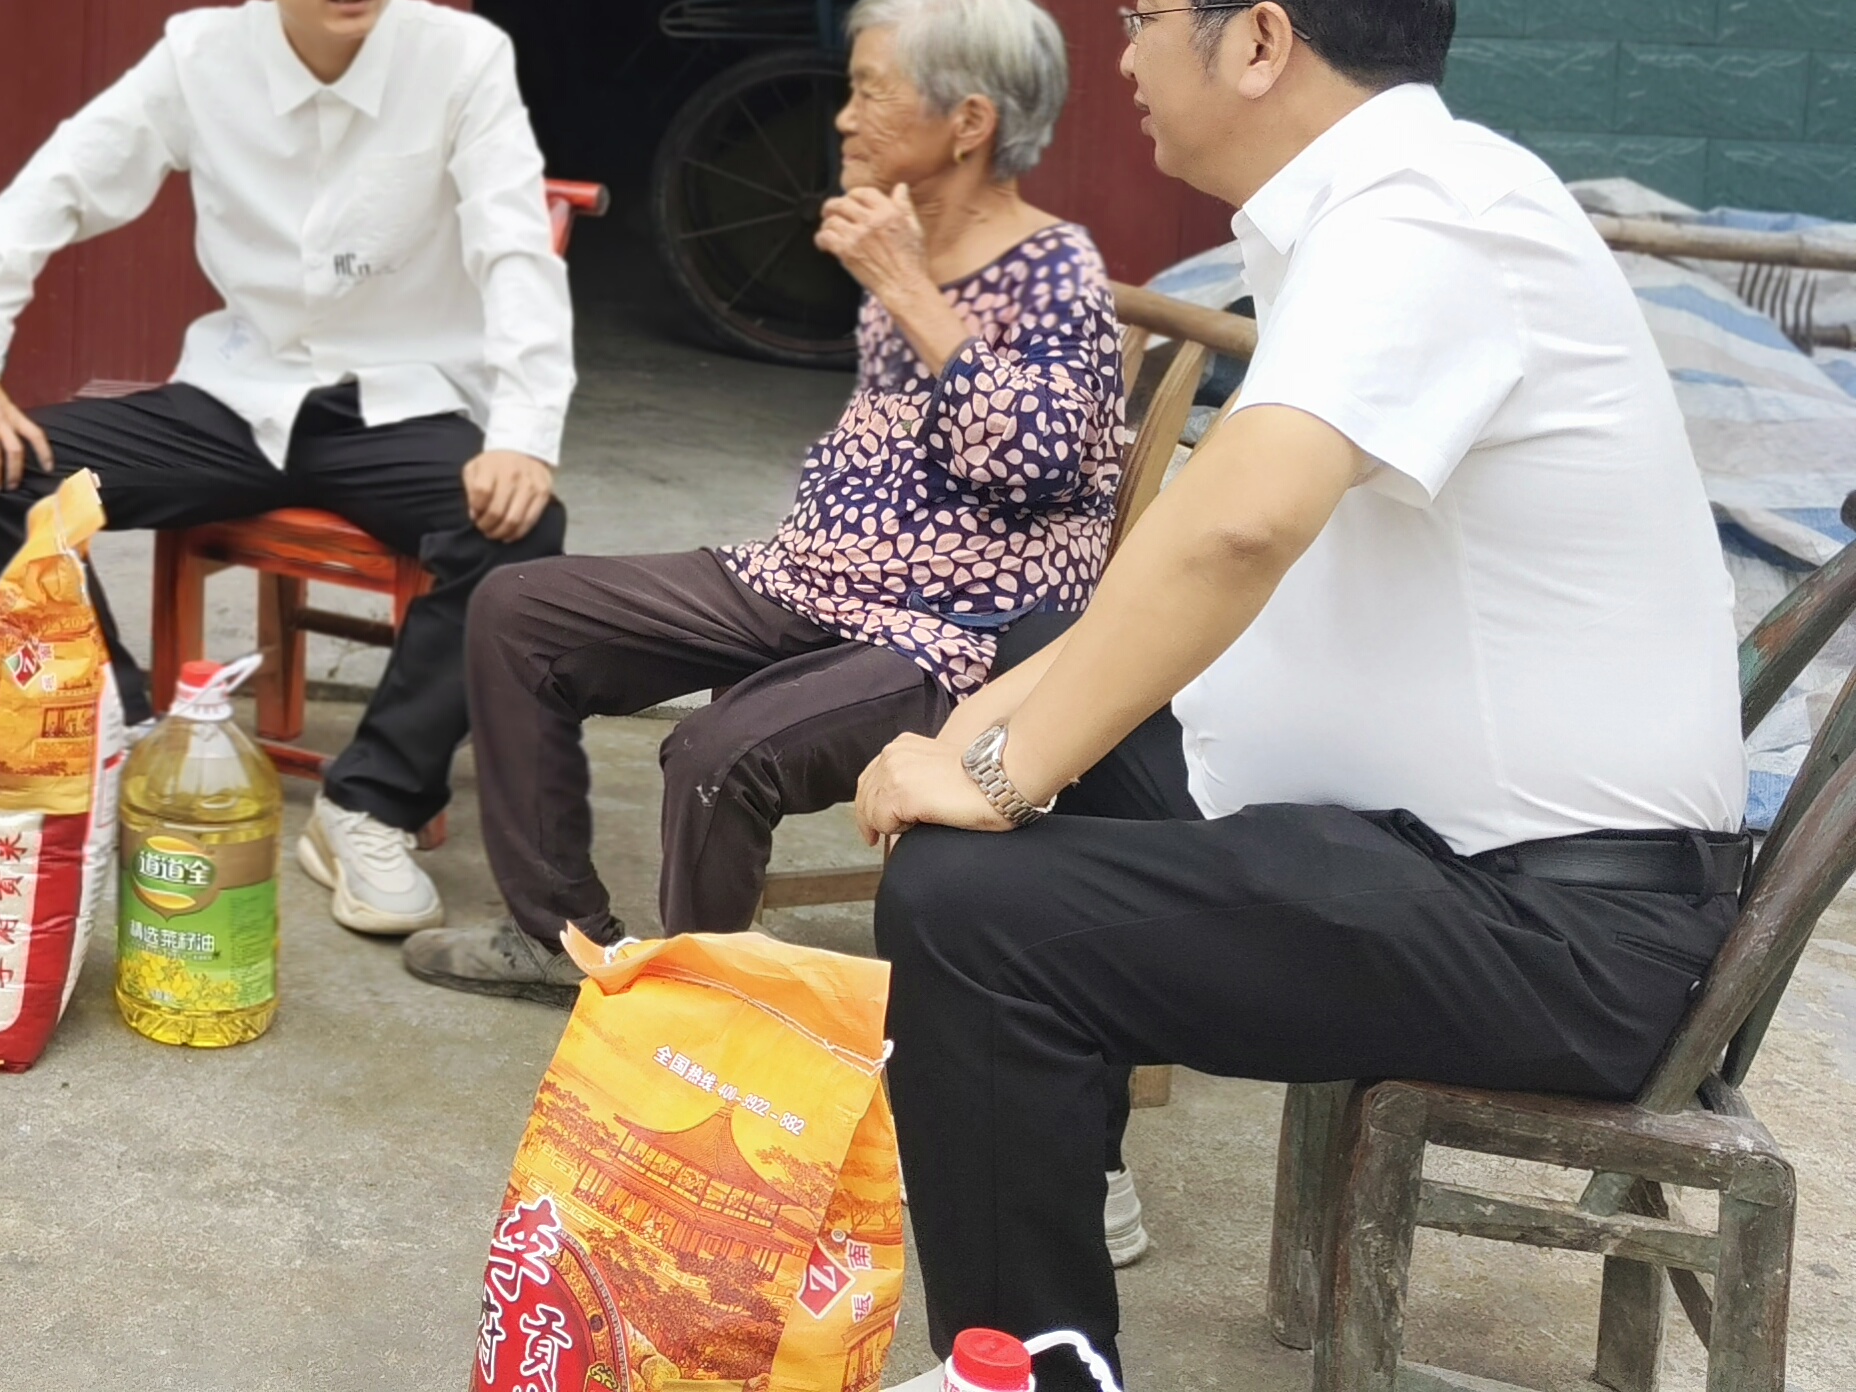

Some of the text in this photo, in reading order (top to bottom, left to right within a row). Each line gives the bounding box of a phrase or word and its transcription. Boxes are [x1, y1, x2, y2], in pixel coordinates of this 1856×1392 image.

[139, 850, 212, 886] 道道全
[130, 919, 215, 953] 精选菜籽油
